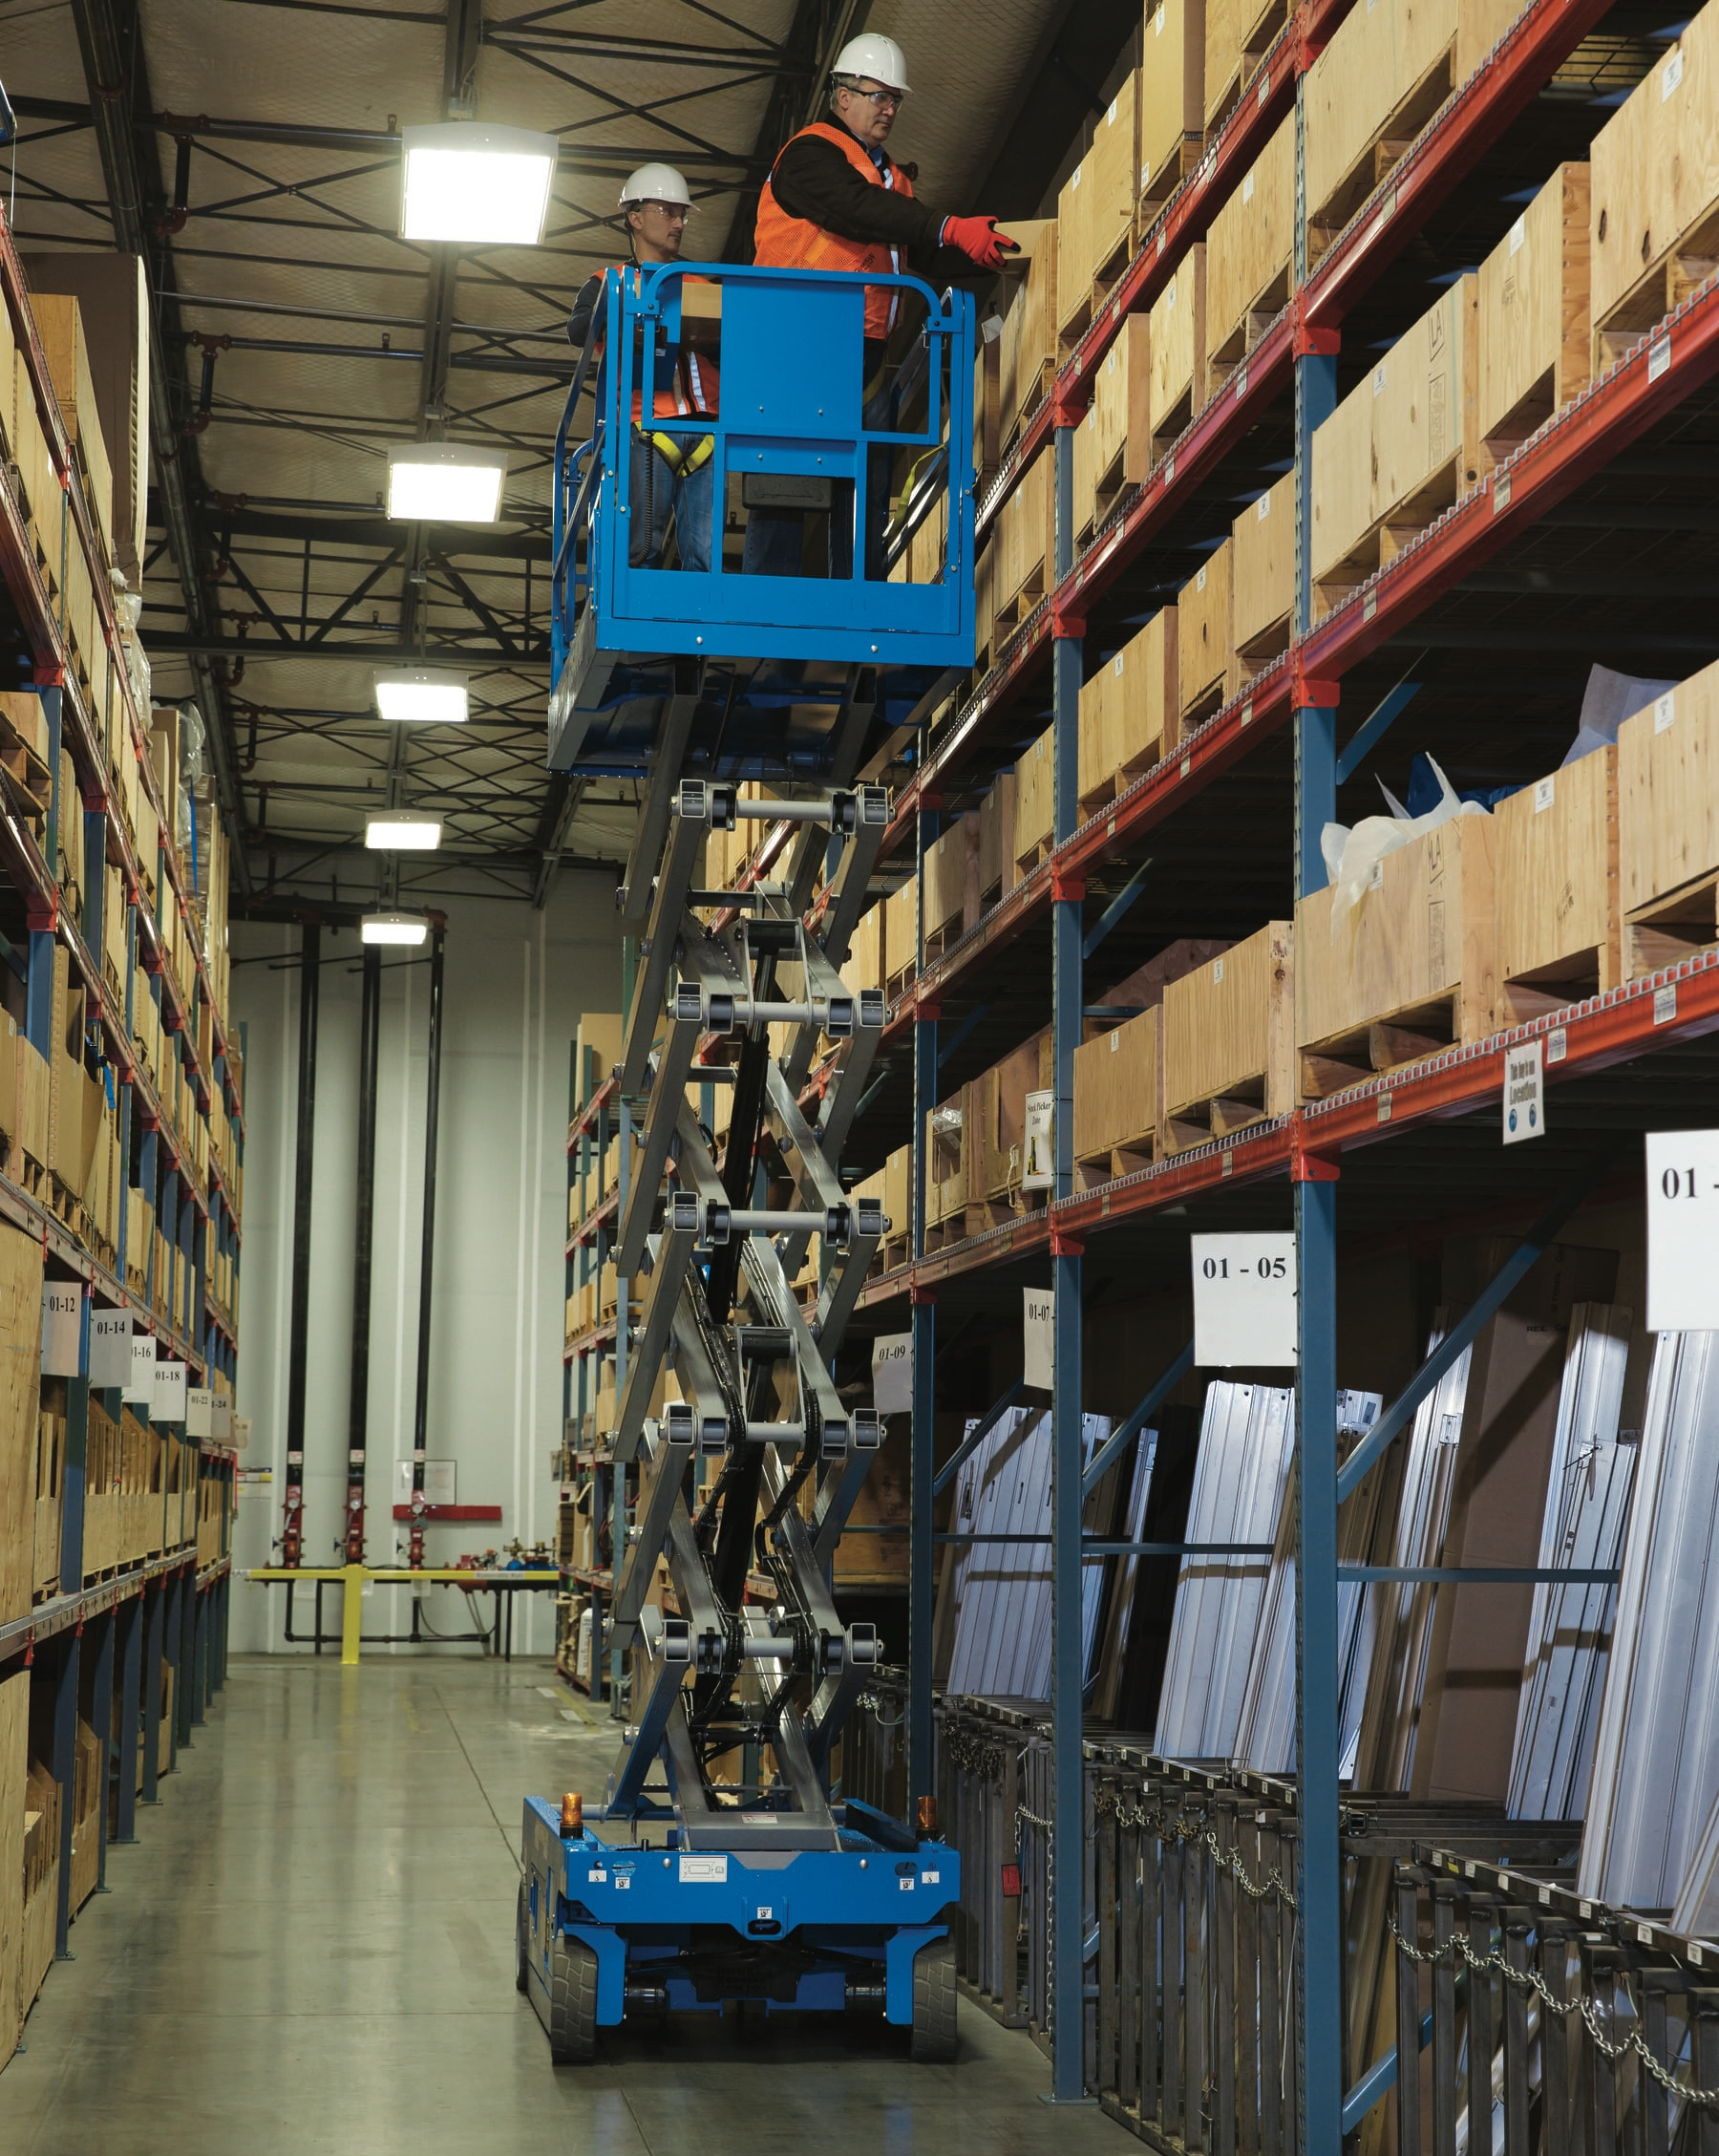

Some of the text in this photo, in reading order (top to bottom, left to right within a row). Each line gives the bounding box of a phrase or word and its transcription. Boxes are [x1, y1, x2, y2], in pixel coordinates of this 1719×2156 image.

[1662, 1167, 1699, 1199] 01
[1202, 1257, 1230, 1278] 01
[1257, 1257, 1287, 1278] 05
[49, 1295, 75, 1313] 01-12
[96, 1321, 126, 1335] 01-14
[879, 1345, 906, 1361] 01-09
[155, 1371, 180, 1381] 01-18
[191, 1396, 208, 1405] 01-22
